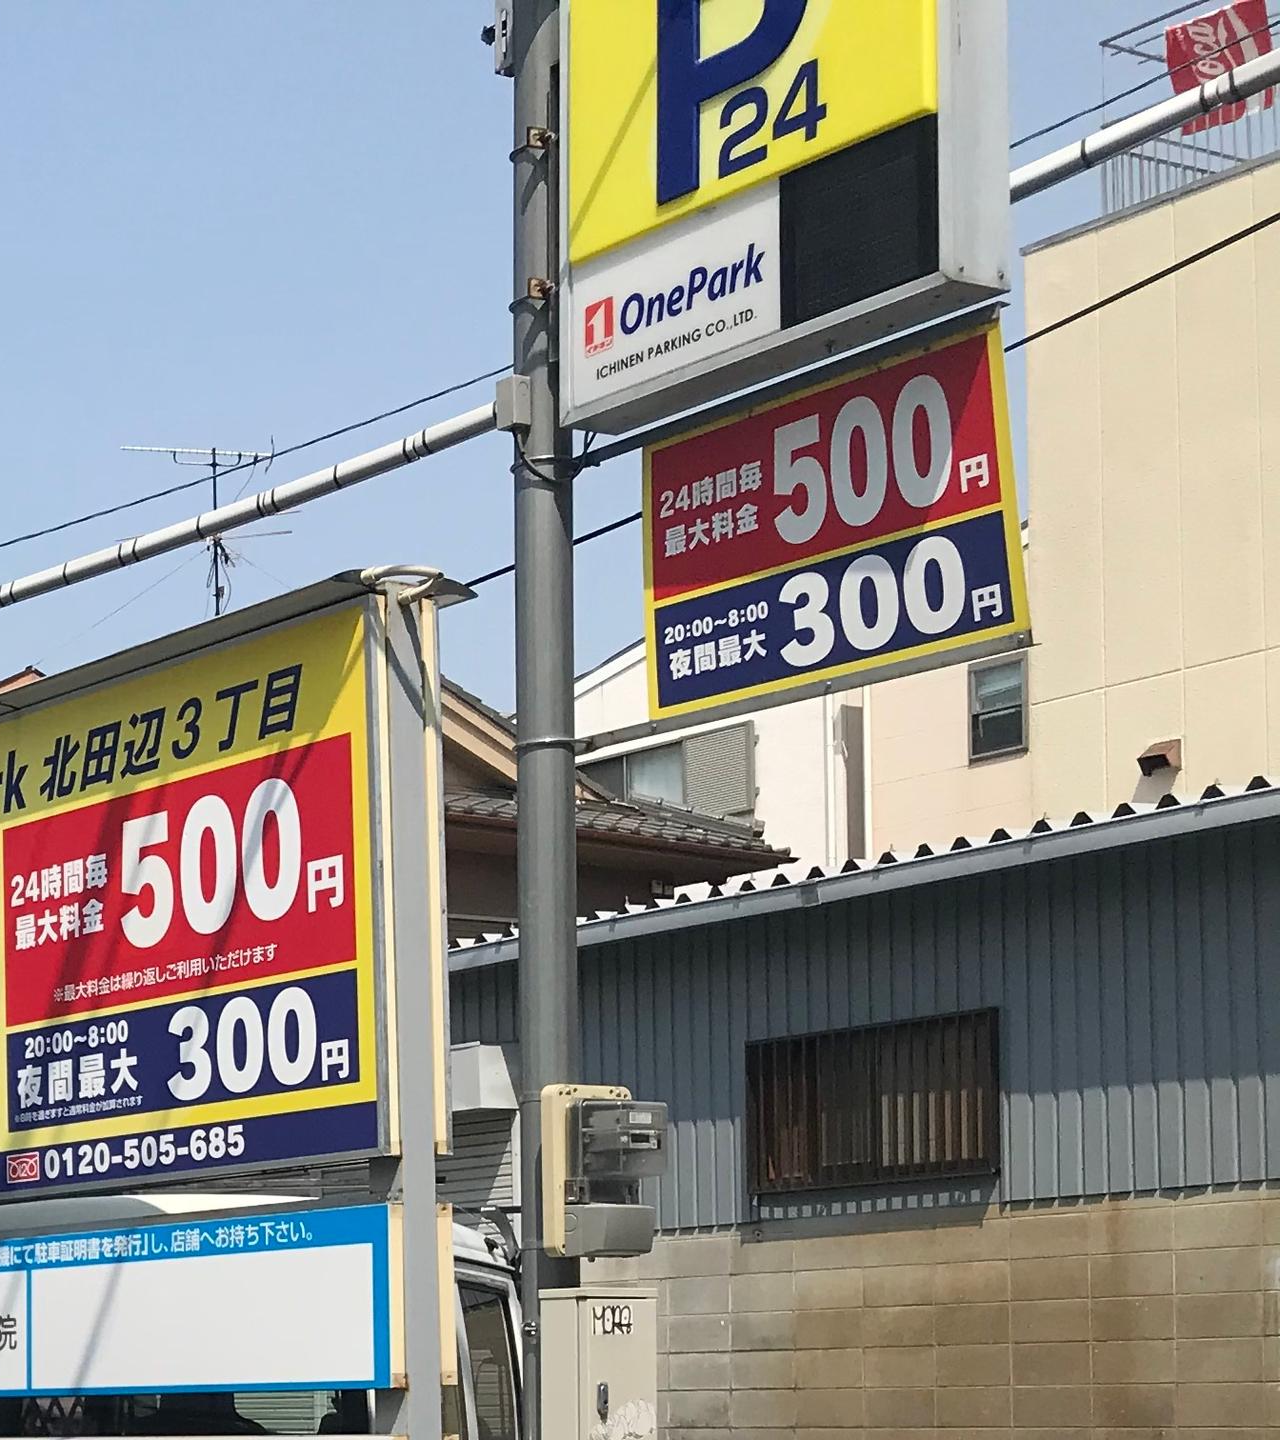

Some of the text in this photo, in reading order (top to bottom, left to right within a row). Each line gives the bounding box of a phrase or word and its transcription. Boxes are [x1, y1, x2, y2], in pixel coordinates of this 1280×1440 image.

[657, 0, 810, 206] P
[718, 59, 828, 180] 24
[620, 243, 766, 335] OnePark
[596, 308, 758, 380] ICHINEN PARKING CO.,LTD.
[659, 460, 762, 519] 24時間毎
[664, 503, 759, 557] 最大料金
[669, 629, 767, 680] 夜間最大
[10, 852, 108, 908] 24時間毎
[15, 899, 104, 950] 最大料金
[17, 1048, 139, 1108] 夜間最大
[44, 1124, 246, 1180] 0120-505-685
